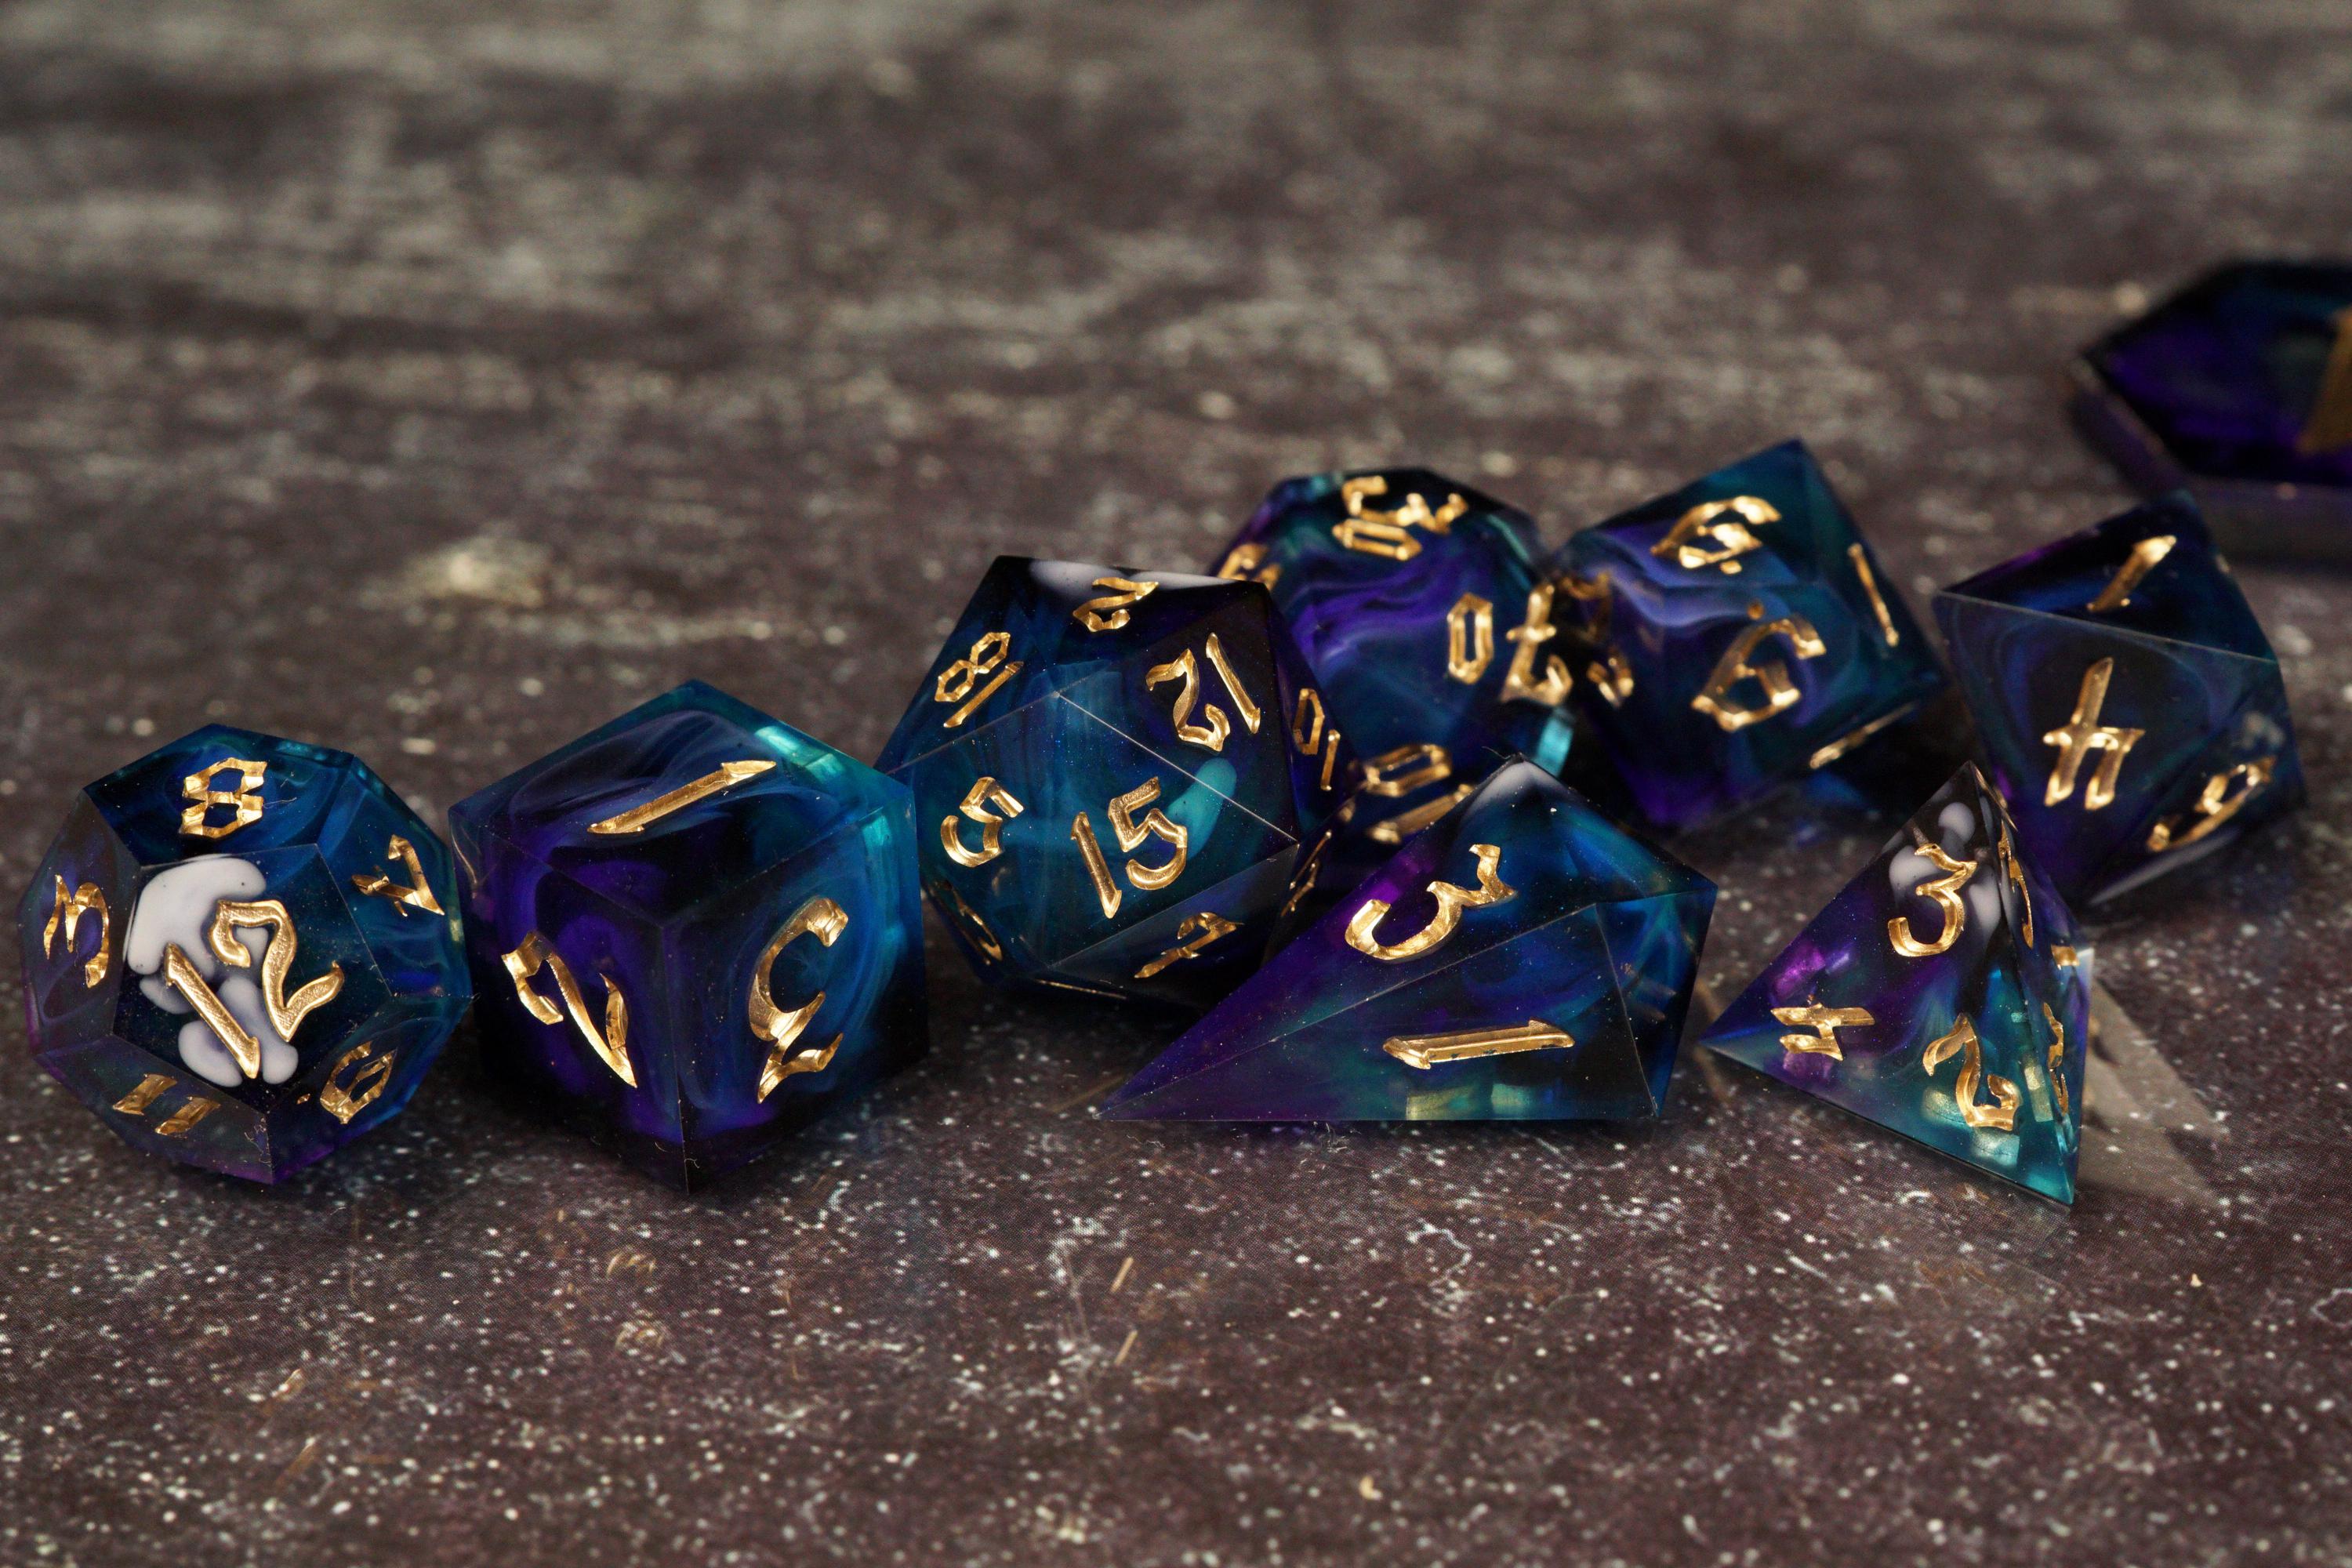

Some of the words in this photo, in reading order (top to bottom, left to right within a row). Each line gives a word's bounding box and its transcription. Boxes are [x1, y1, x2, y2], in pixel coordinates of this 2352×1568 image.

[2089, 535, 2178, 612] 1
[178, 757, 268, 839] 8
[586, 759, 777, 834] 1
[940, 776, 1025, 868] 5
[1070, 775, 1189, 920] 15
[1345, 843, 1518, 961] 3
[1887, 842, 1979, 958] 3
[165, 898, 346, 1080] 12
[1382, 1019, 1576, 1070] 1
[1922, 1012, 2020, 1132] 2
